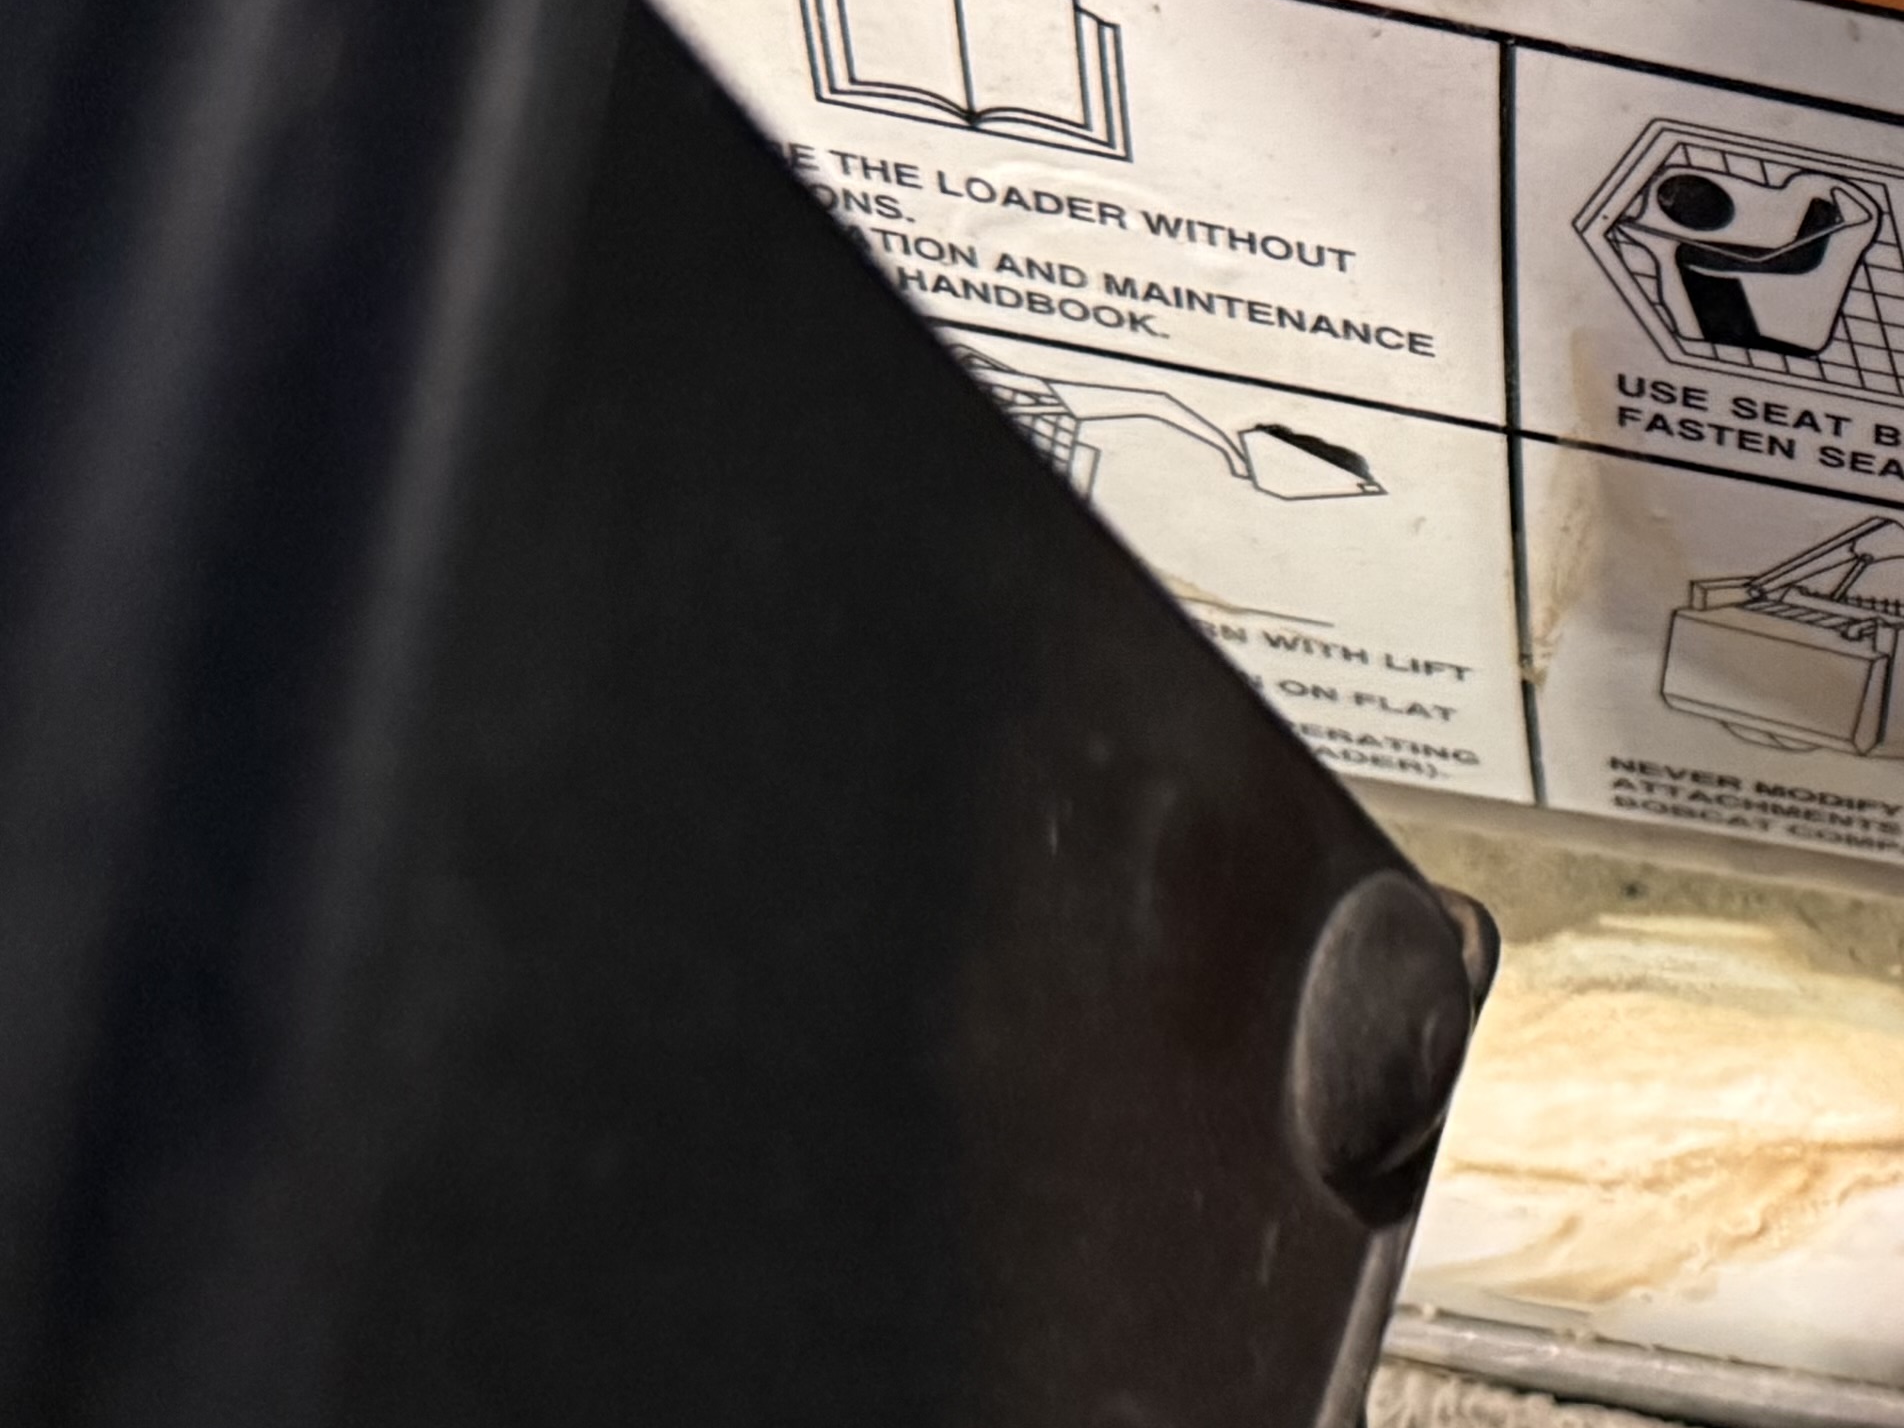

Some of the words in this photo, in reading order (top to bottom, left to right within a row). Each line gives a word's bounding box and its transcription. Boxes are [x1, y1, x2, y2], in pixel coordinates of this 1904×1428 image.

[808, 183, 916, 223] ONS.
[829, 149, 923, 189] THE
[938, 170, 1127, 229] LOADER
[1142, 209, 1356, 272] WITHOUT
[898, 266, 1170, 338] HANDBOOK.
[995, 252, 1087, 290] AND
[1104, 271, 1436, 357] MAINTENANCE
[1617, 373, 1709, 411] USE
[1731, 396, 1851, 437] SEAT
[1617, 406, 1796, 460] FASTEN
[1262, 630, 1368, 665] WITH
[1385, 653, 1473, 681] LIFT
[1278, 678, 1338, 702] ON
[1353, 691, 1457, 722] FLAT
[1296, 722, 1480, 766] ERATING
[1610, 756, 1742, 791] NEVER
[1754, 780, 1904, 818] MODIFY
[1612, 776, 1902, 836] ATTACHMENTS
[1613, 794, 1770, 832] BOBCAT
